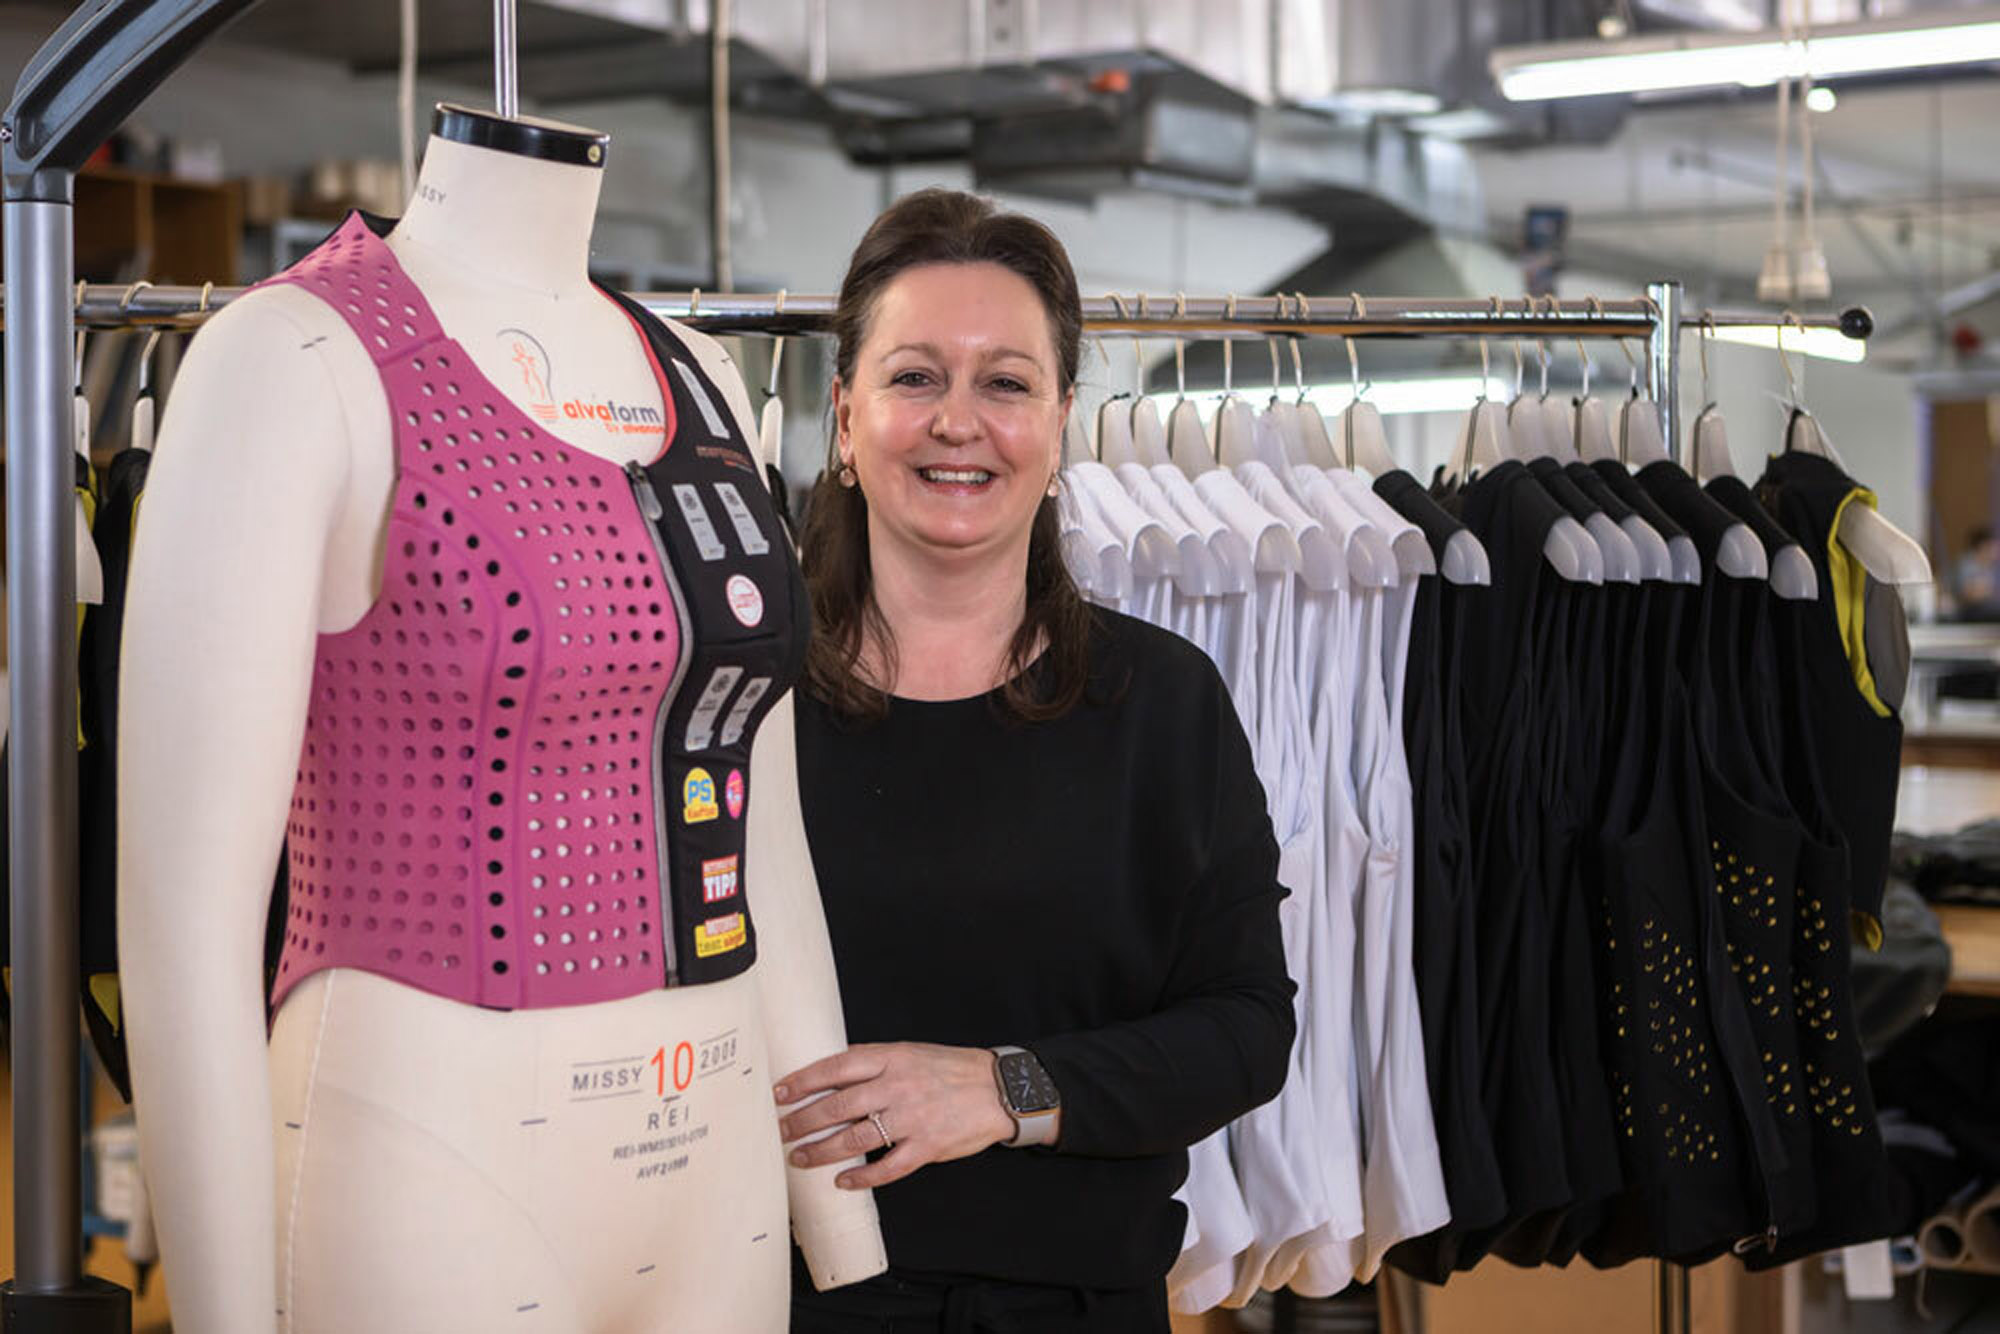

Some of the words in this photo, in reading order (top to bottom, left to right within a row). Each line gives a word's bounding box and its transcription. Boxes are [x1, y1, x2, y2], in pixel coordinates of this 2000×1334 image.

[563, 399, 661, 422] alvaform
[687, 779, 712, 804] PS
[703, 872, 737, 900] TIPP
[571, 1066, 643, 1091] MISSY
[650, 1040, 694, 1097] 10
